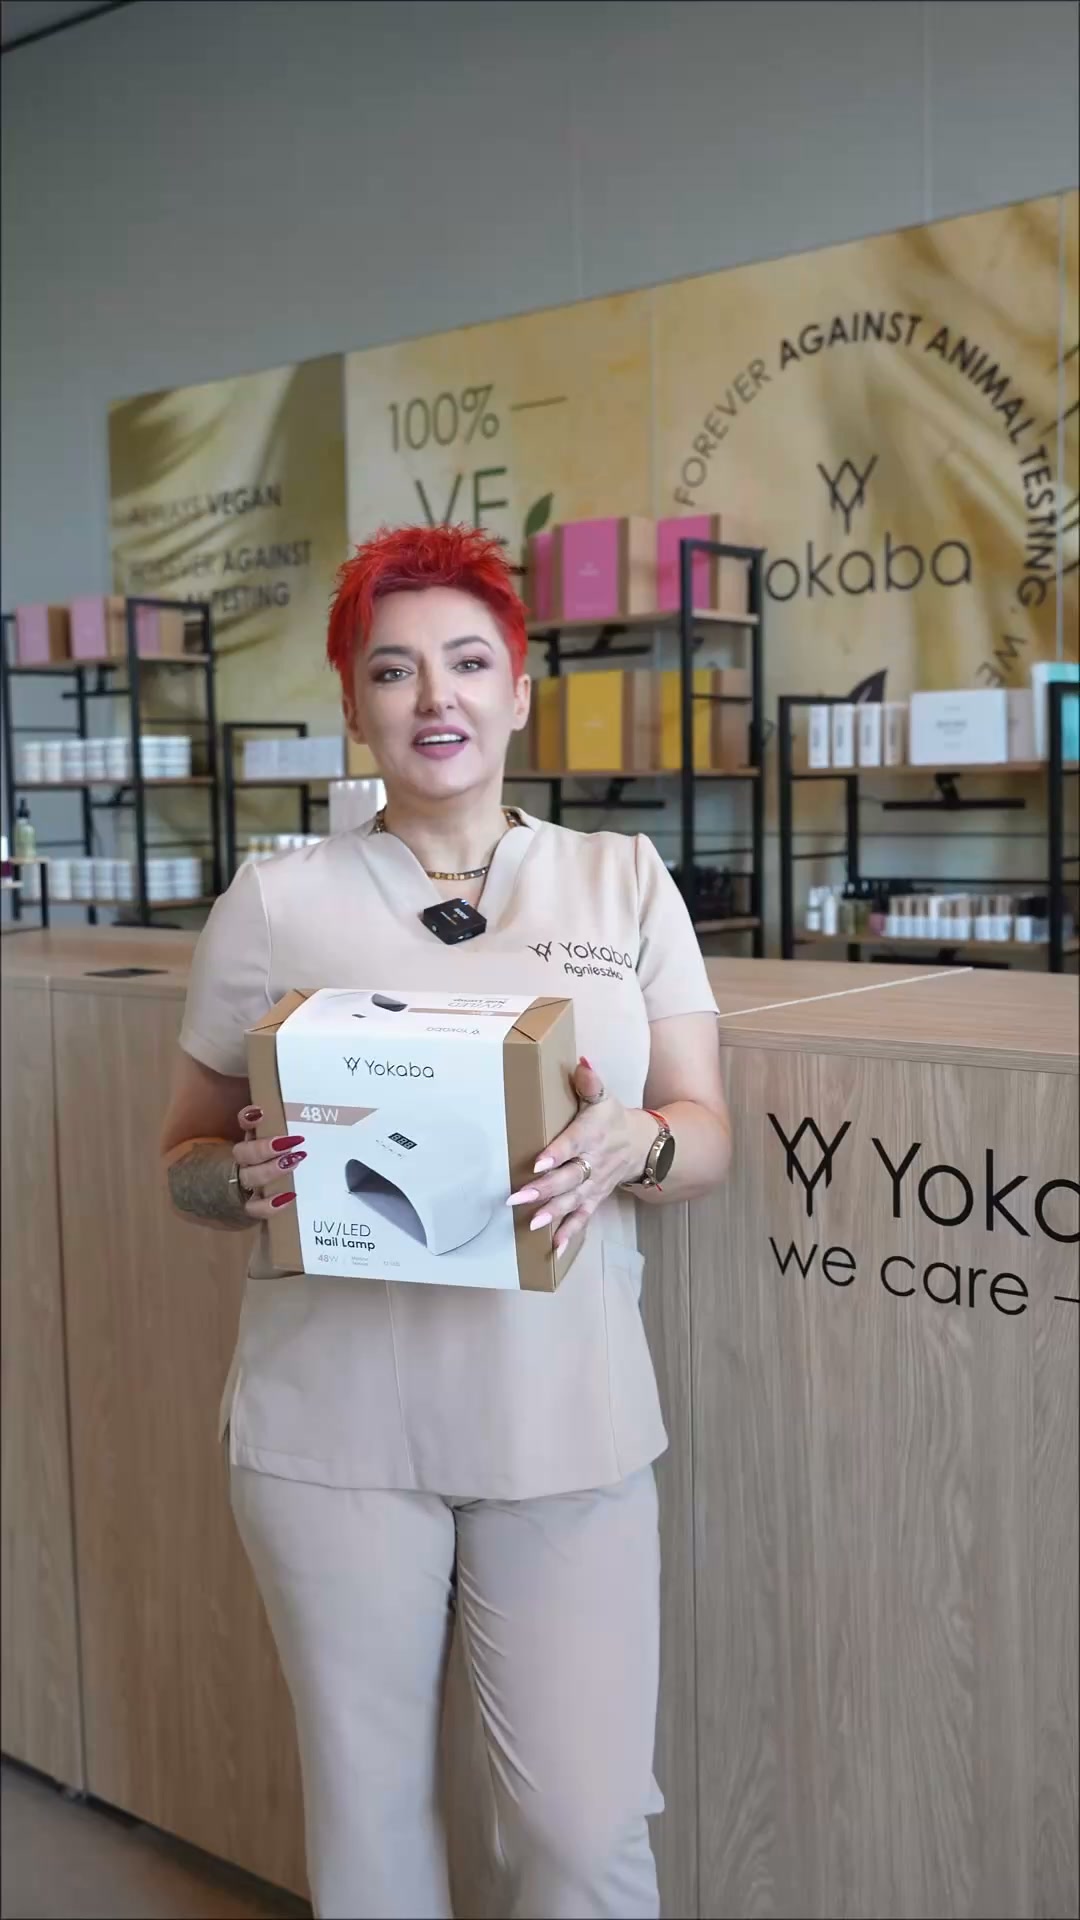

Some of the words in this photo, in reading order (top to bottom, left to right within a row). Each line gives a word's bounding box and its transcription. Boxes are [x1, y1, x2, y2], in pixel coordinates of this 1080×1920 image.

[388, 384, 500, 453] 100%
[673, 358, 772, 508] FOREVER
[779, 312, 923, 371] AGAINST
[924, 325, 1036, 445] ANIMAL
[1016, 444, 1059, 608] TESTING
[207, 483, 282, 515] VEGAN
[223, 540, 312, 572] AGAINST
[766, 530, 972, 602] okaba
[557, 941, 633, 969] Yokaba
[563, 962, 624, 981] Agnieszka
[365, 1059, 434, 1078] Yokaba
[300, 1106, 339, 1122] 48W
[313, 1219, 371, 1237] UV/LED
[315, 1235, 338, 1247] Nail
[341, 1238, 376, 1251] Lamp
[318, 1254, 339, 1263] 48W
[769, 1236, 857, 1287] we
[880, 1255, 1029, 1316] care
